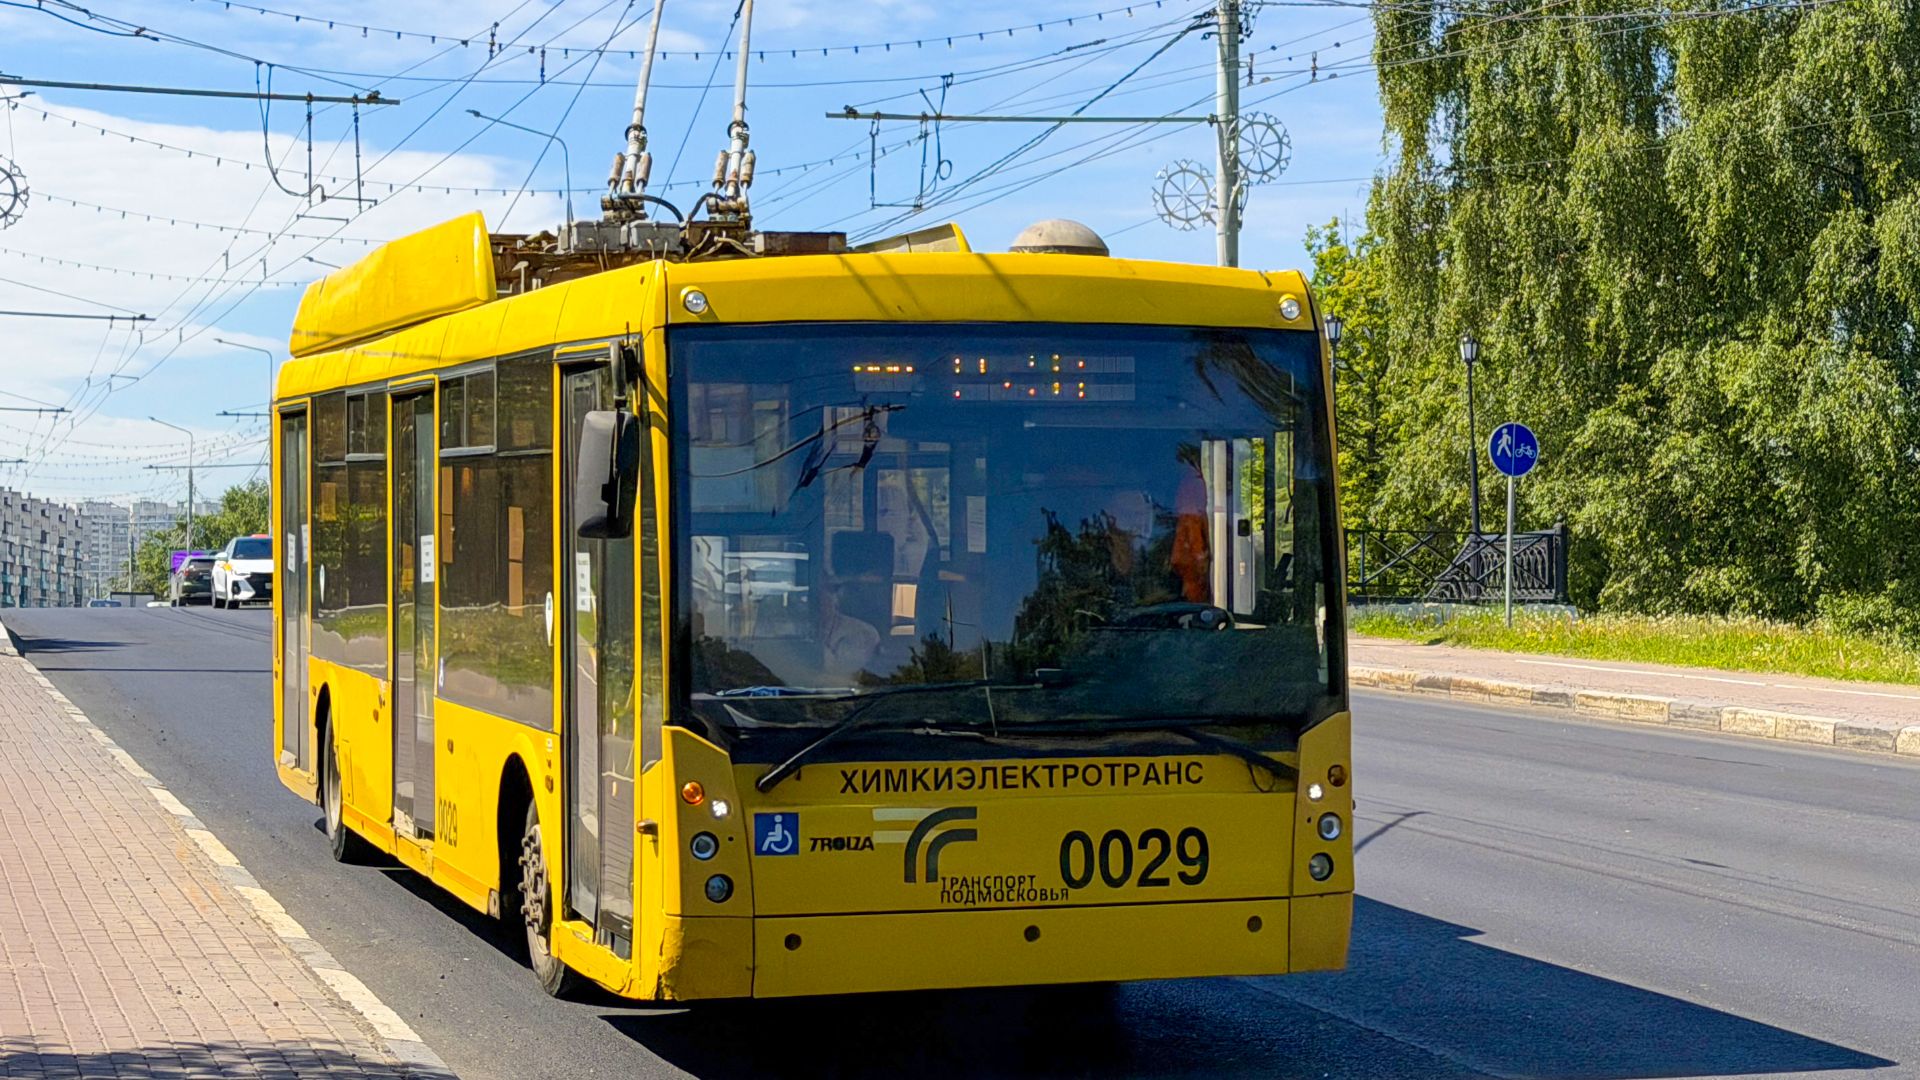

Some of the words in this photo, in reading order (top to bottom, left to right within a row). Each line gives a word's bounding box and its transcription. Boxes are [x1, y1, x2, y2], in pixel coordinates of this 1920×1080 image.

[839, 761, 1204, 794] ХИМКИЭЛЕКТРОТРАНС
[438, 797, 458, 848] 0029
[809, 835, 875, 852] TROLZA
[1059, 826, 1210, 890] 0029
[940, 875, 1037, 891] ТРАНСПОРТ
[940, 887, 1069, 905] ПОДМОСКОВЬЯ
